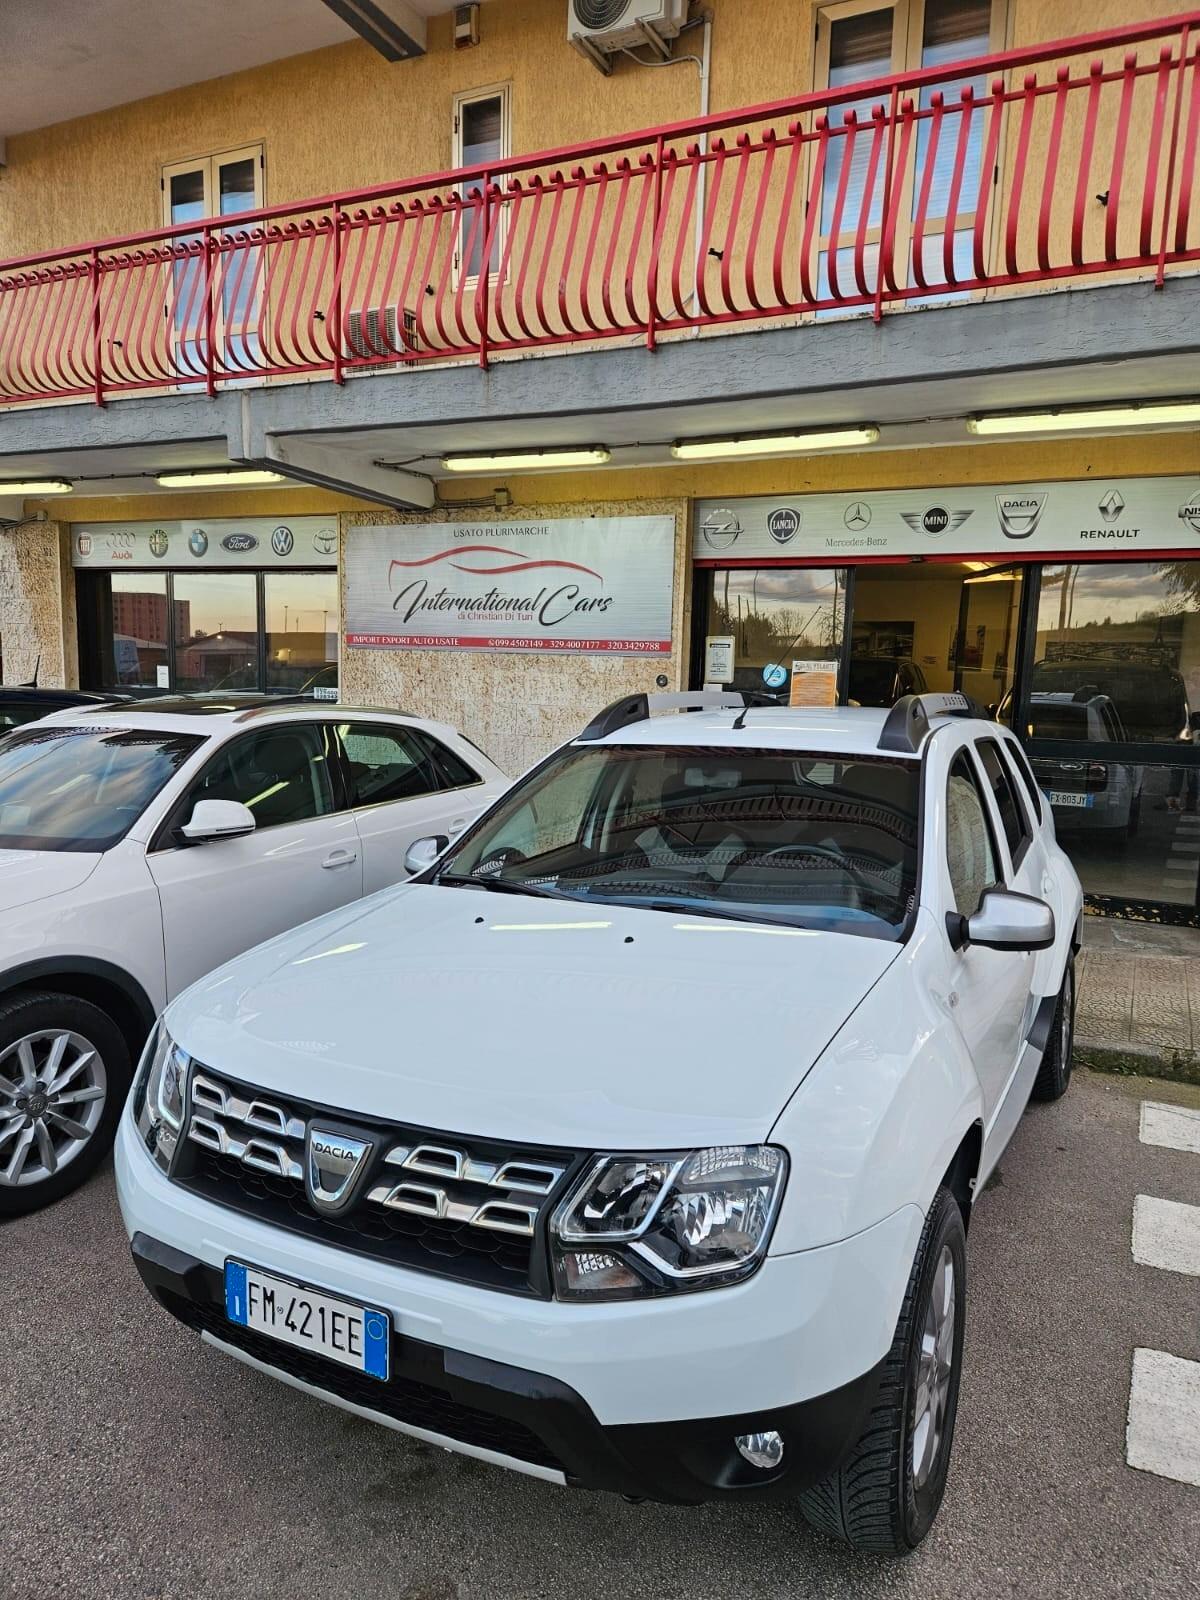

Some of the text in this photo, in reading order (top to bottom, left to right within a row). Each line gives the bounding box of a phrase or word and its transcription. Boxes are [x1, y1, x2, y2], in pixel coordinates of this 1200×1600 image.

[1003, 500, 1038, 508] DACIA
[772, 519, 795, 530] LANCIA
[924, 515, 947, 526] MINI
[453, 526, 551, 538] USATO PLURIMARCHE
[1080, 529, 1140, 539] RENAULT
[228, 536, 250, 549] Ford
[825, 537, 888, 548] Mercedes-Benz
[393, 579, 614, 627] International Cars
[457, 611, 533, 620] di Christian Di Turi
[353, 635, 459, 646] IMPORT EXPORT AUTO USATE
[495, 638, 543, 648] 099.4502149
[550, 640, 600, 649] 329.4007177
[607, 640, 661, 651] 320.3429788
[314, 1142, 355, 1161] DACIA
